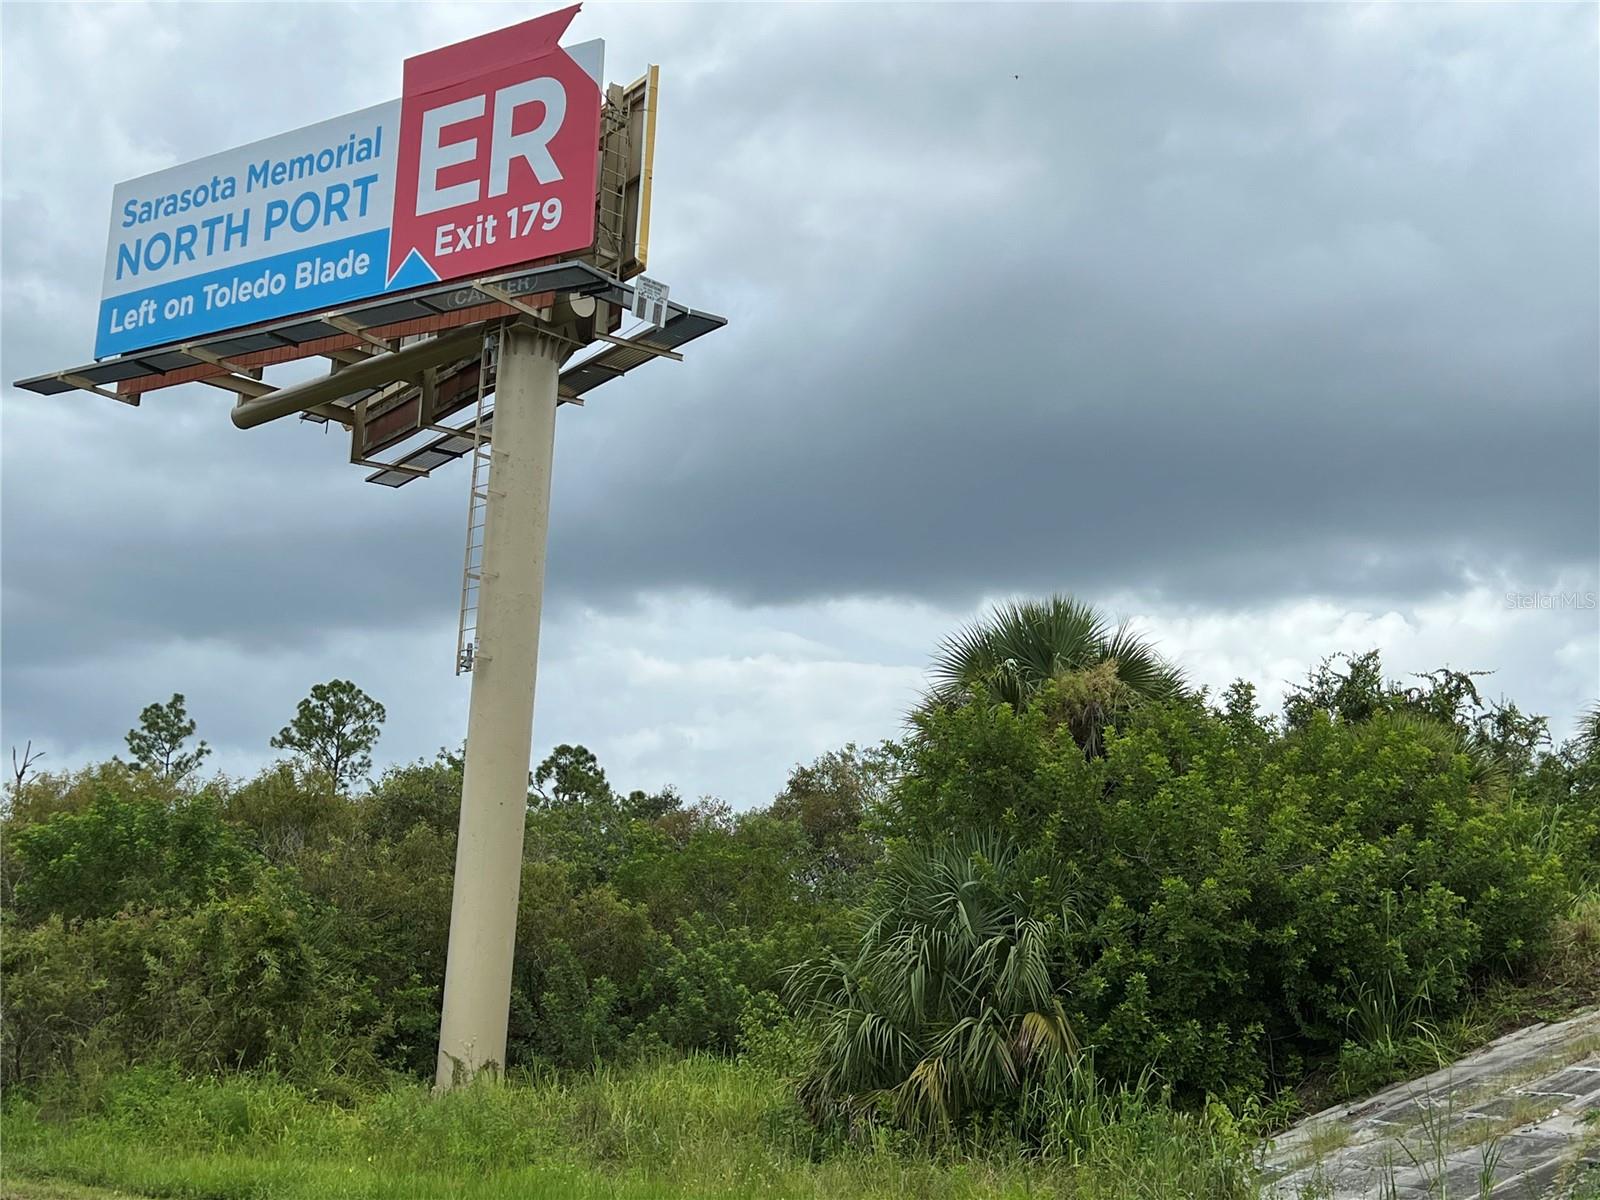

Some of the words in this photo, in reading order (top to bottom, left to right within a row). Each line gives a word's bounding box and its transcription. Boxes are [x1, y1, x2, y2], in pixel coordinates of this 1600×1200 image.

[122, 175, 235, 228] Sarasota
[246, 126, 382, 193] Memorial
[415, 76, 567, 217] ER
[115, 208, 250, 280] NORTH
[263, 174, 379, 241] PORT
[434, 215, 497, 257] Exit
[506, 197, 563, 239] 179
[109, 299, 158, 335] Left
[163, 295, 193, 319] on
[203, 270, 286, 311] Toledo
[294, 249, 370, 290] Blade
[454, 276, 531, 305] CATER
